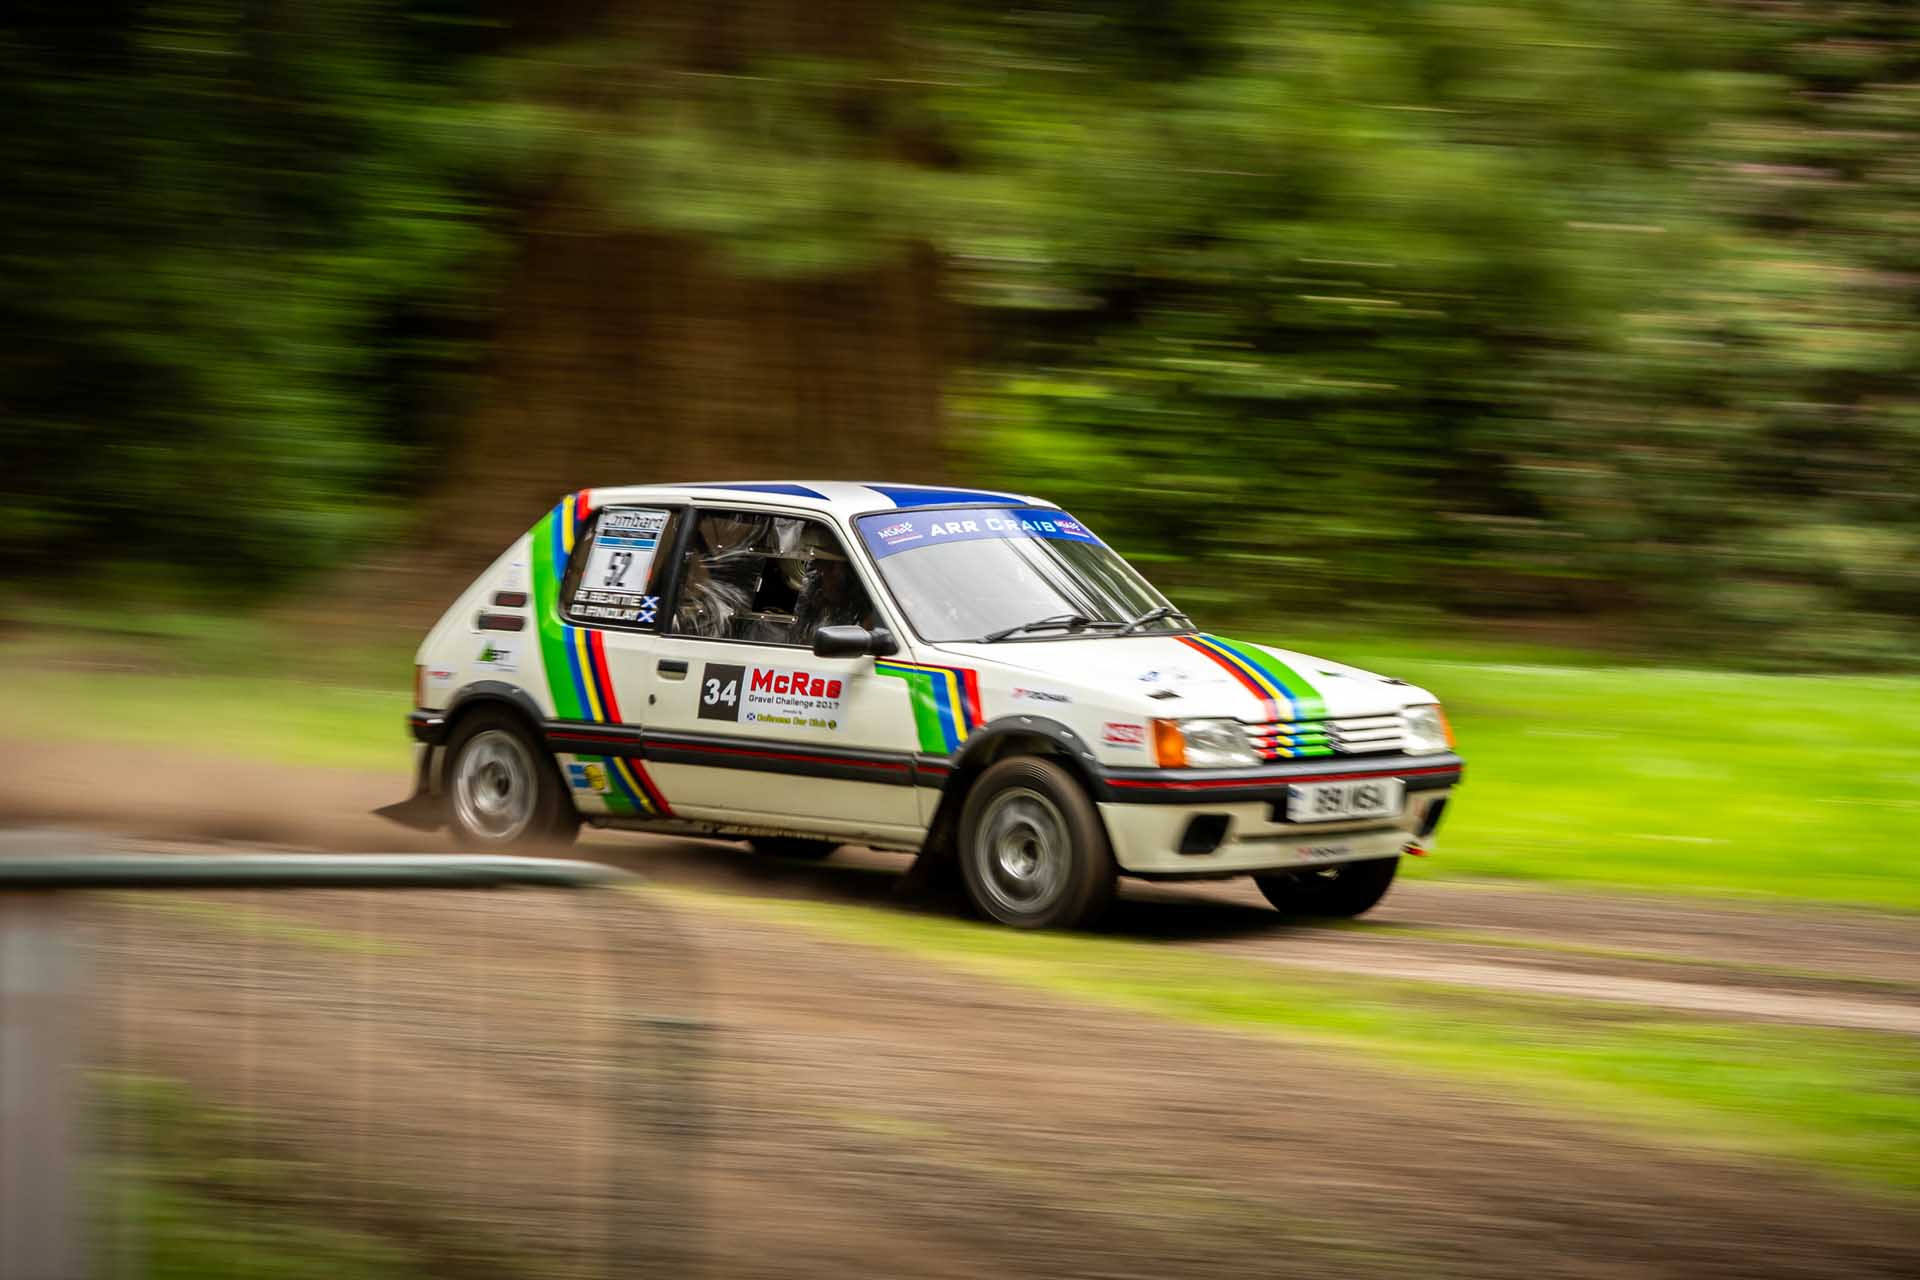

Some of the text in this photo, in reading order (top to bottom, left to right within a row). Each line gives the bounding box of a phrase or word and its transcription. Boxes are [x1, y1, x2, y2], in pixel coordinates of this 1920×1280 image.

[930, 520, 980, 537] ARR
[603, 551, 633, 587] 52
[703, 678, 737, 707] 34
[750, 668, 842, 699] McRae
[749, 695, 840, 710] Gravel Challenge 2017
